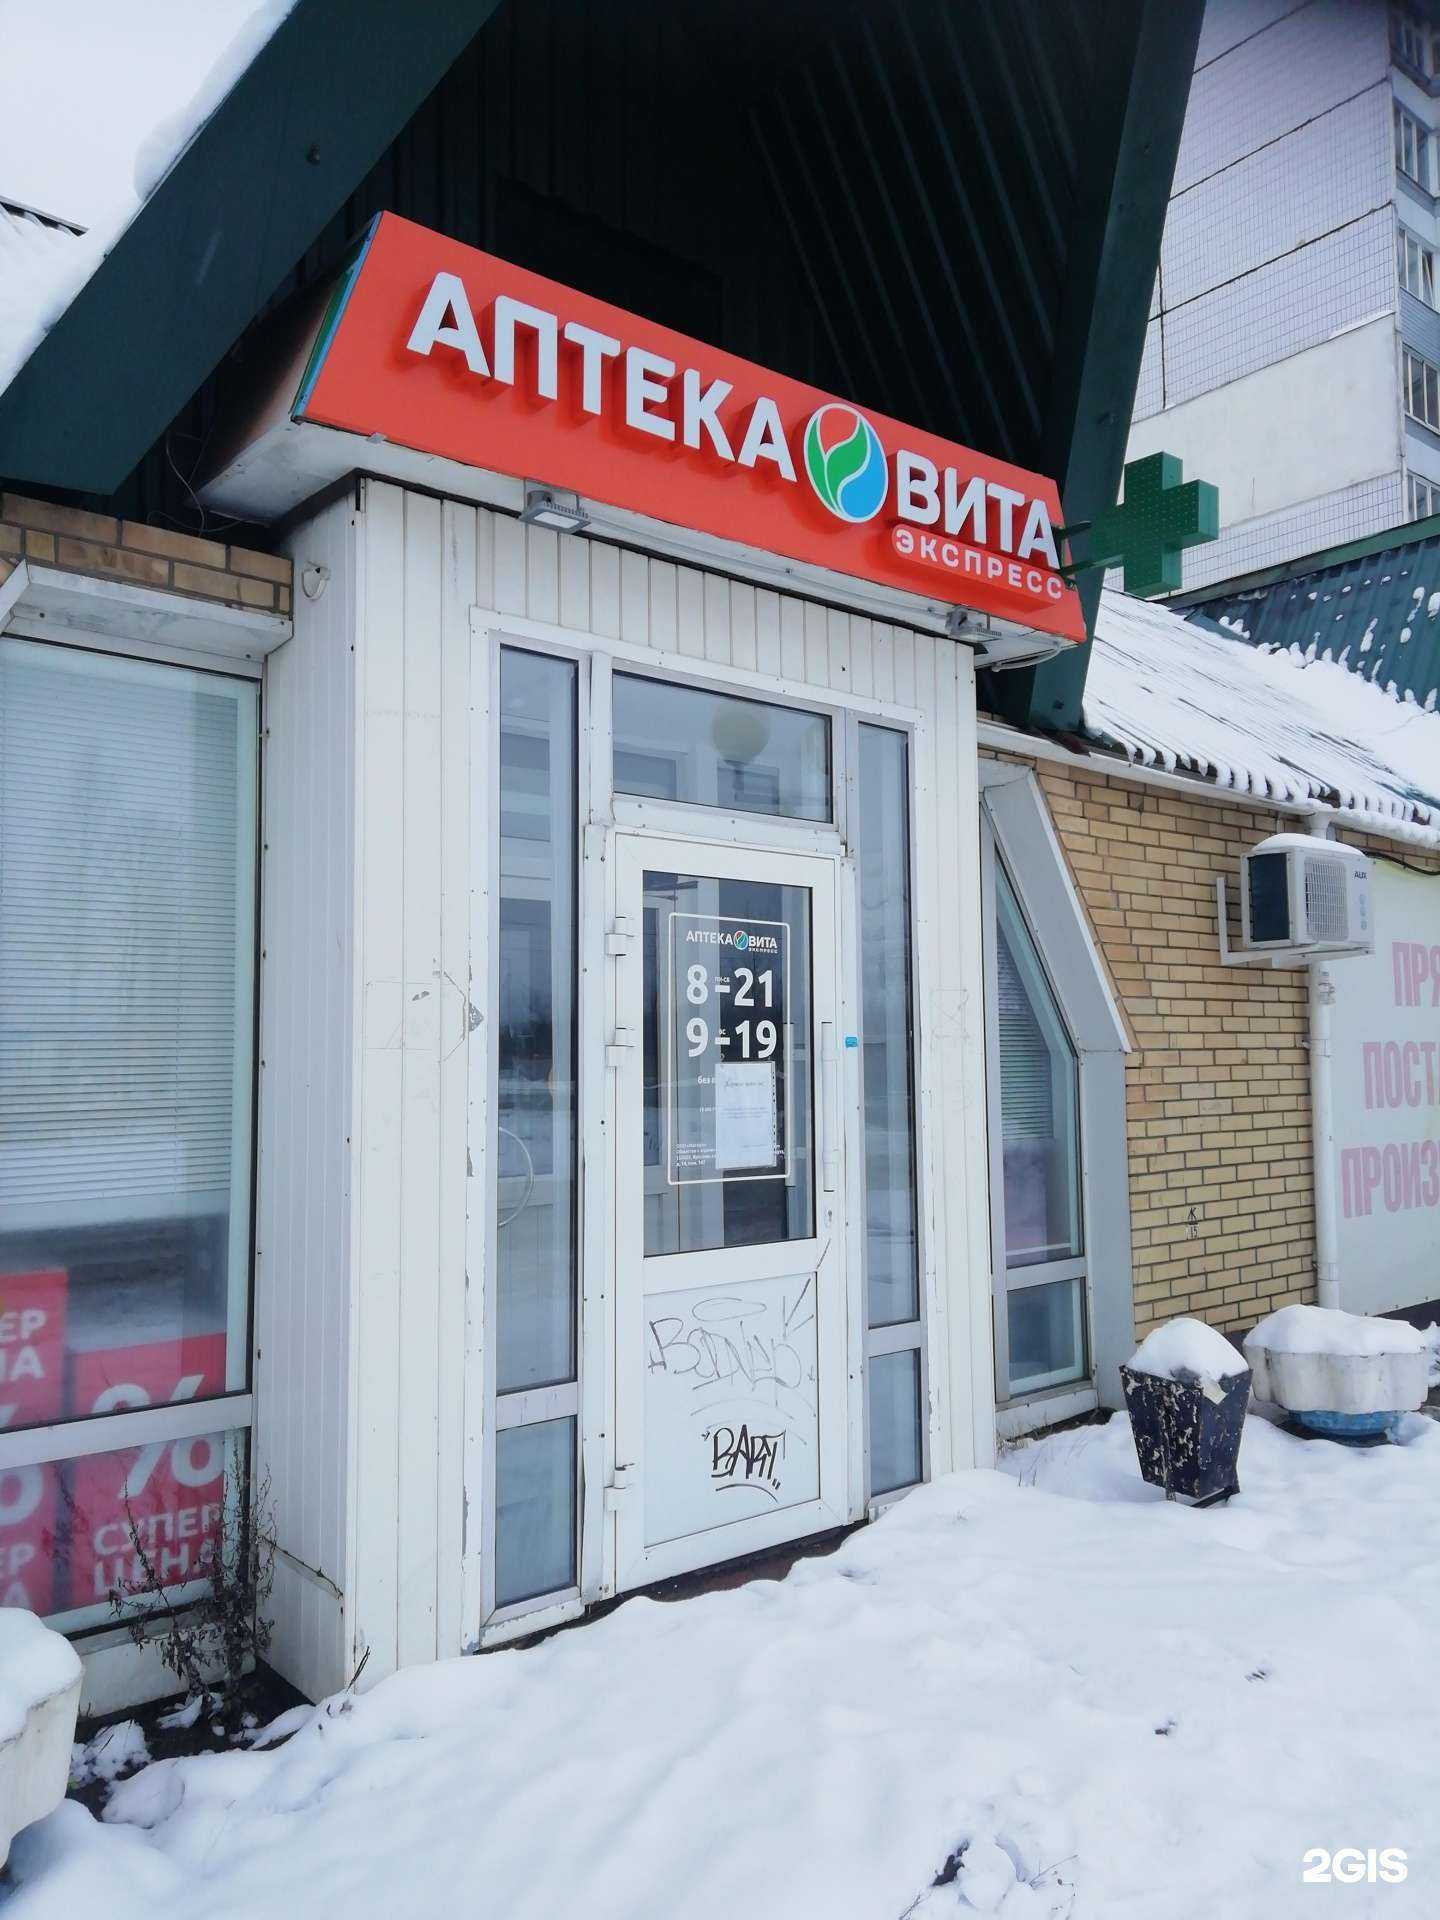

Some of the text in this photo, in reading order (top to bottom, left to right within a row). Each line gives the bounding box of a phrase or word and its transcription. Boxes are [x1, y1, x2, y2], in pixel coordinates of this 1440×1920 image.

[406, 271, 1061, 570] АПТЕКА ВИТА
[895, 528, 1063, 600] ЭКСПРЕСС
[686, 930, 778, 949] АПТЕКА ВИТА
[94, 1503, 222, 1556] СУПЕР
